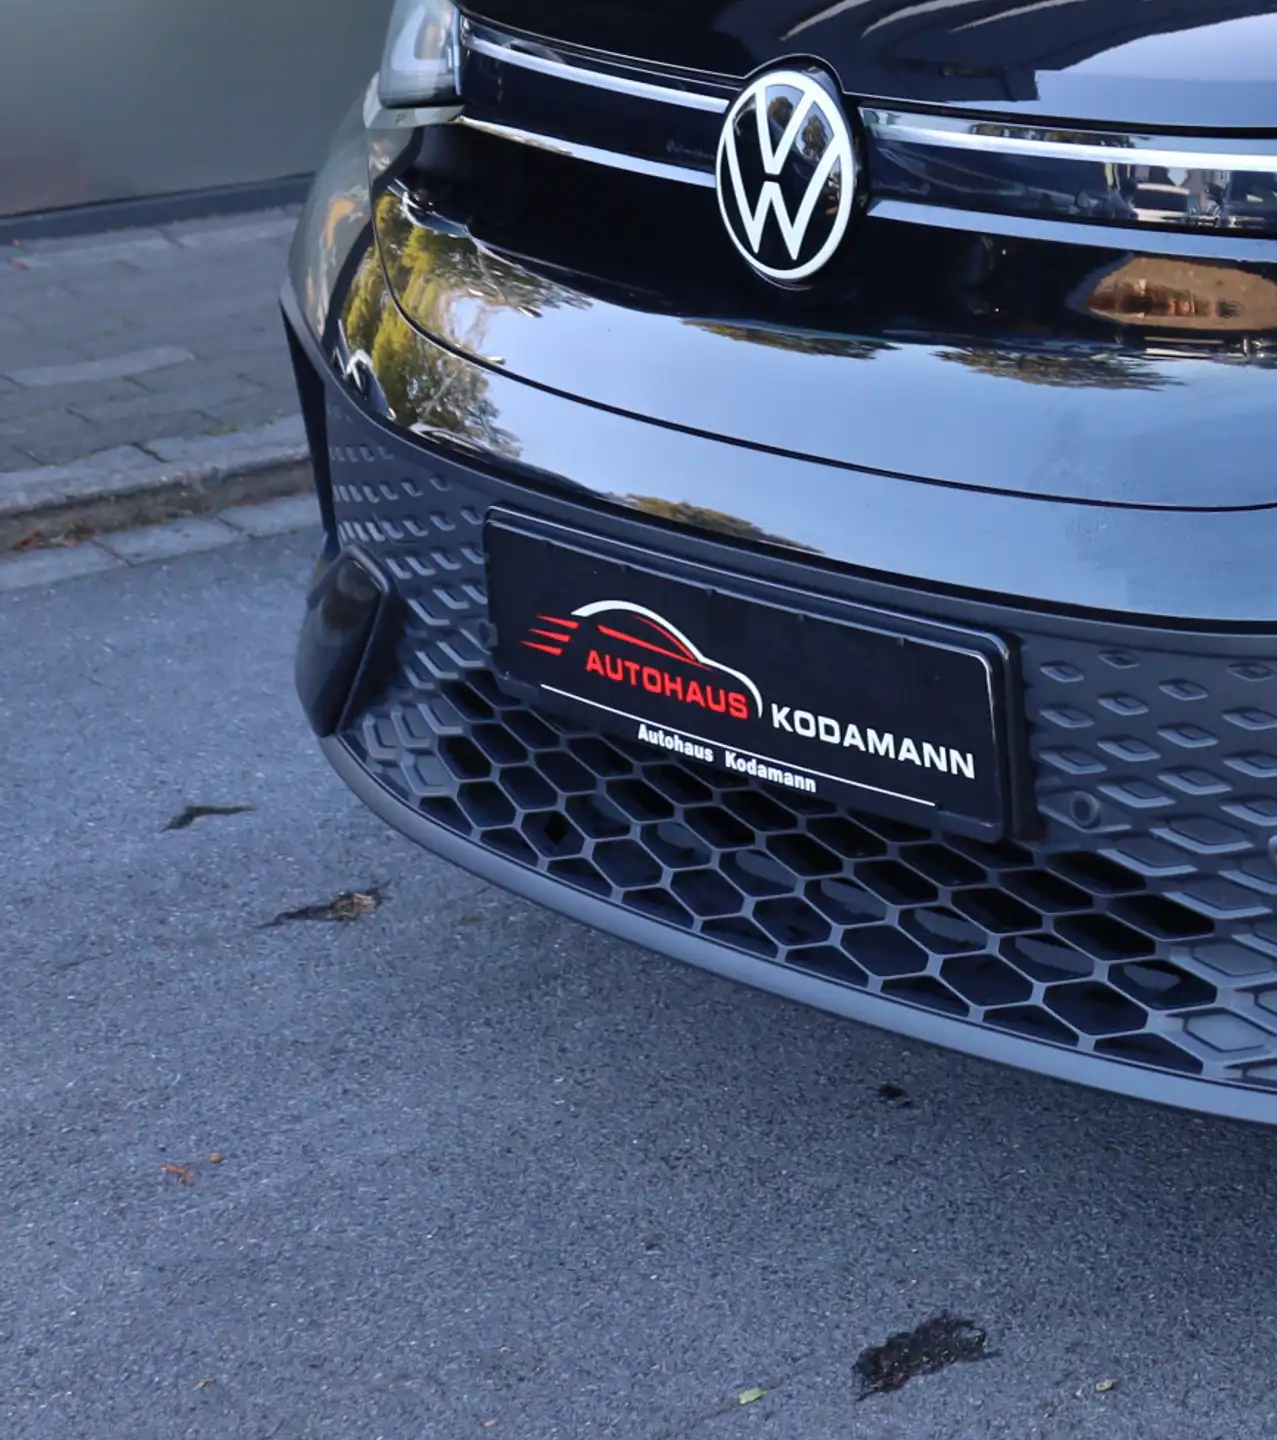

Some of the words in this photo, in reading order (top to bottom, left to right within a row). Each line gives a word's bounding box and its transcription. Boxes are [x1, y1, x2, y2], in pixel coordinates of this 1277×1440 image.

[585, 648, 748, 720] AUTOHAUS
[771, 702, 975, 779] KODAMANN
[637, 723, 714, 762] Autohaus
[724, 750, 816, 793] Kodamann
